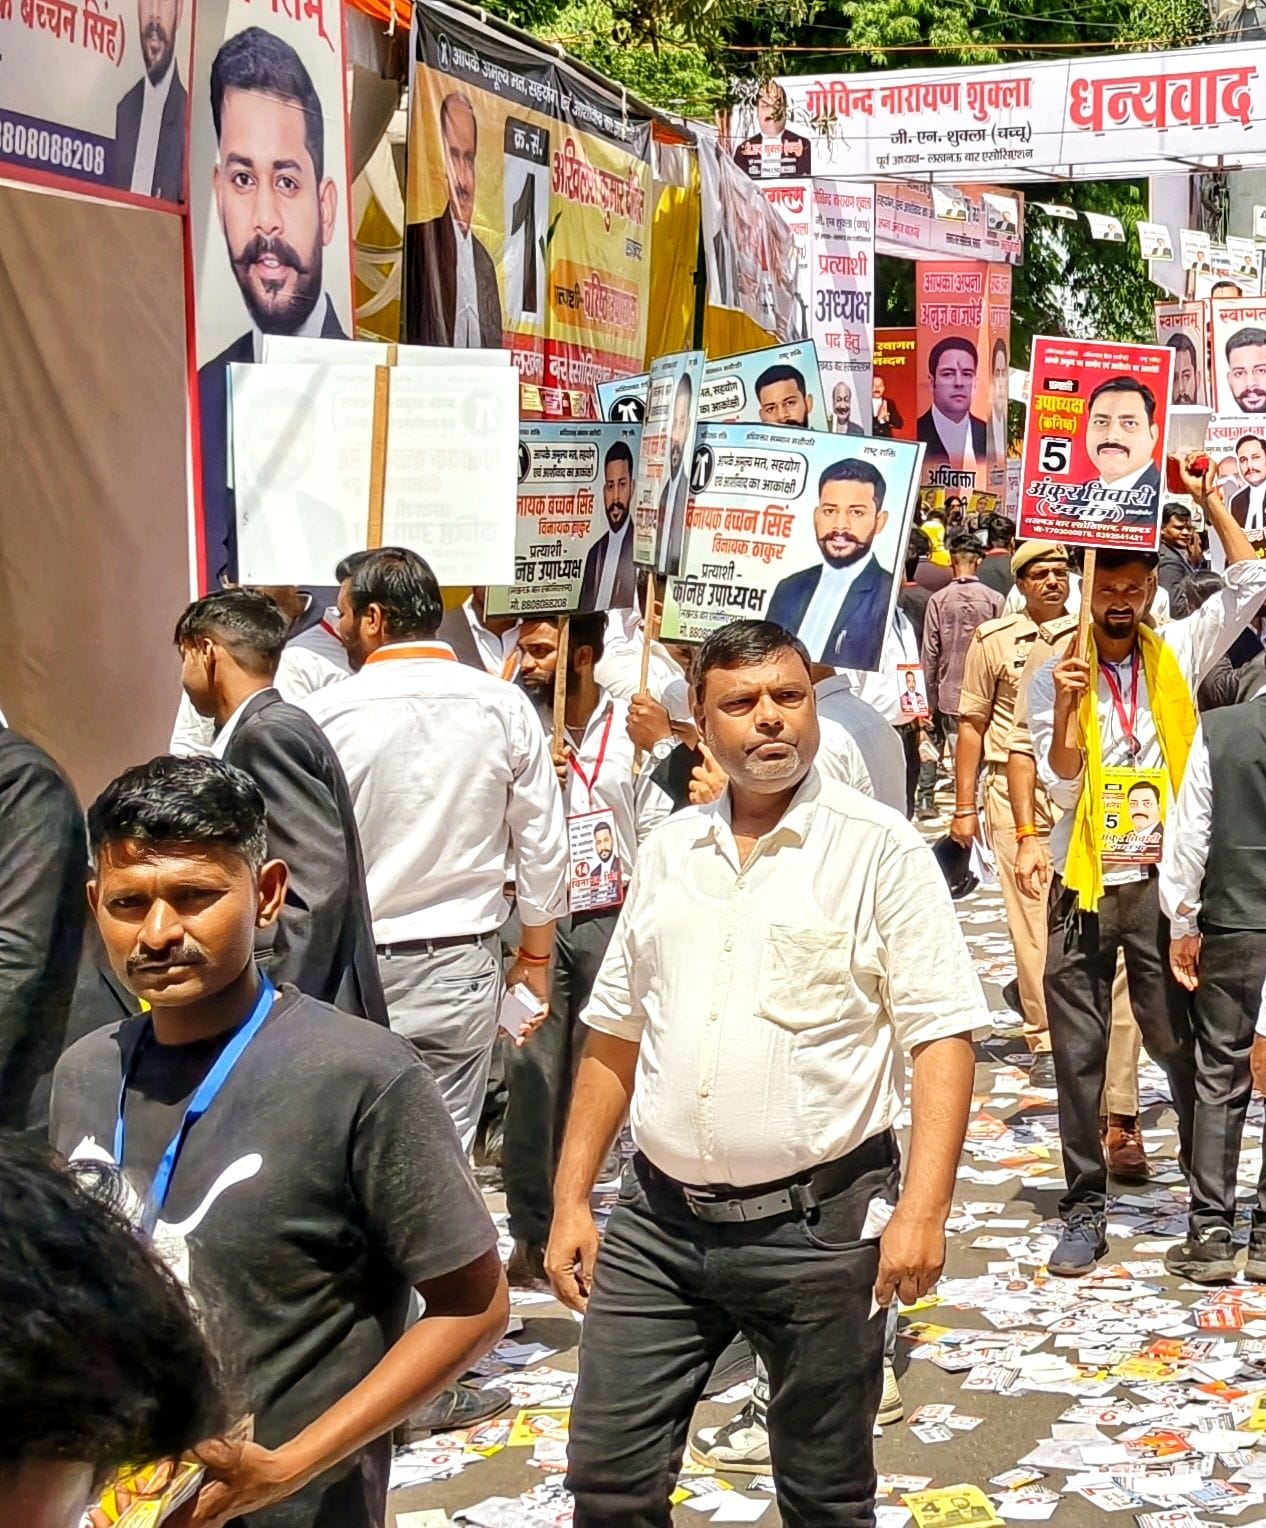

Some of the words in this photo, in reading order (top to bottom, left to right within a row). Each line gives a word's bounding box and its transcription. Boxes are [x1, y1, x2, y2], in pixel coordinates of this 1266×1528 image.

[21, 0, 77, 43] बच्चन
[83, 0, 125, 67] सिंह)
[452, 47, 480, 73] आपके
[806, 80, 874, 117] गोविन्द
[880, 82, 961, 116] नारायण
[966, 77, 1032, 120] शुक्ला
[1069, 65, 1257, 137] धन्यवाद
[0, 120, 105, 175] 808088208
[947, 128, 986, 147] शुक्ला
[511, 173, 536, 313] 1
[818, 251, 868, 277] प्रत्याशी
[924, 272, 954, 293] आपका
[955, 272, 982, 292] अपना
[815, 289, 871, 324] अध्यक्ष
[1159, 312, 1200, 332] स्वागतम्
[825, 333, 841, 348] पद
[844, 330, 860, 354] हेतु
[1034, 394, 1086, 414] उपाध्यक्ष
[754, 457, 770, 472] मत,
[771, 458, 801, 475] सहयोग
[1042, 442, 1066, 472] 5
[748, 478, 761, 491] का
[762, 479, 797, 495] आकांक्षी
[928, 465, 977, 488] अधिवक्ता
[576, 487, 594, 515] सिंह
[1027, 477, 1082, 503] अंकुर
[1083, 480, 1156, 506] तिवारी
[762, 504, 795, 539] सिंह
[530, 540, 562, 558] प्रत्याशी
[712, 533, 750, 555] विनायक
[752, 541, 785, 563] ठाकुर
[539, 559, 582, 580] उपाध्यक्ष
[702, 561, 735, 581] प्रत्याशी
[673, 575, 707, 606] कनिष्ठ
[708, 583, 767, 611] उपाध्यक्ष
[1105, 814, 1119, 829] 5
[921, 1502, 941, 1513] 4
